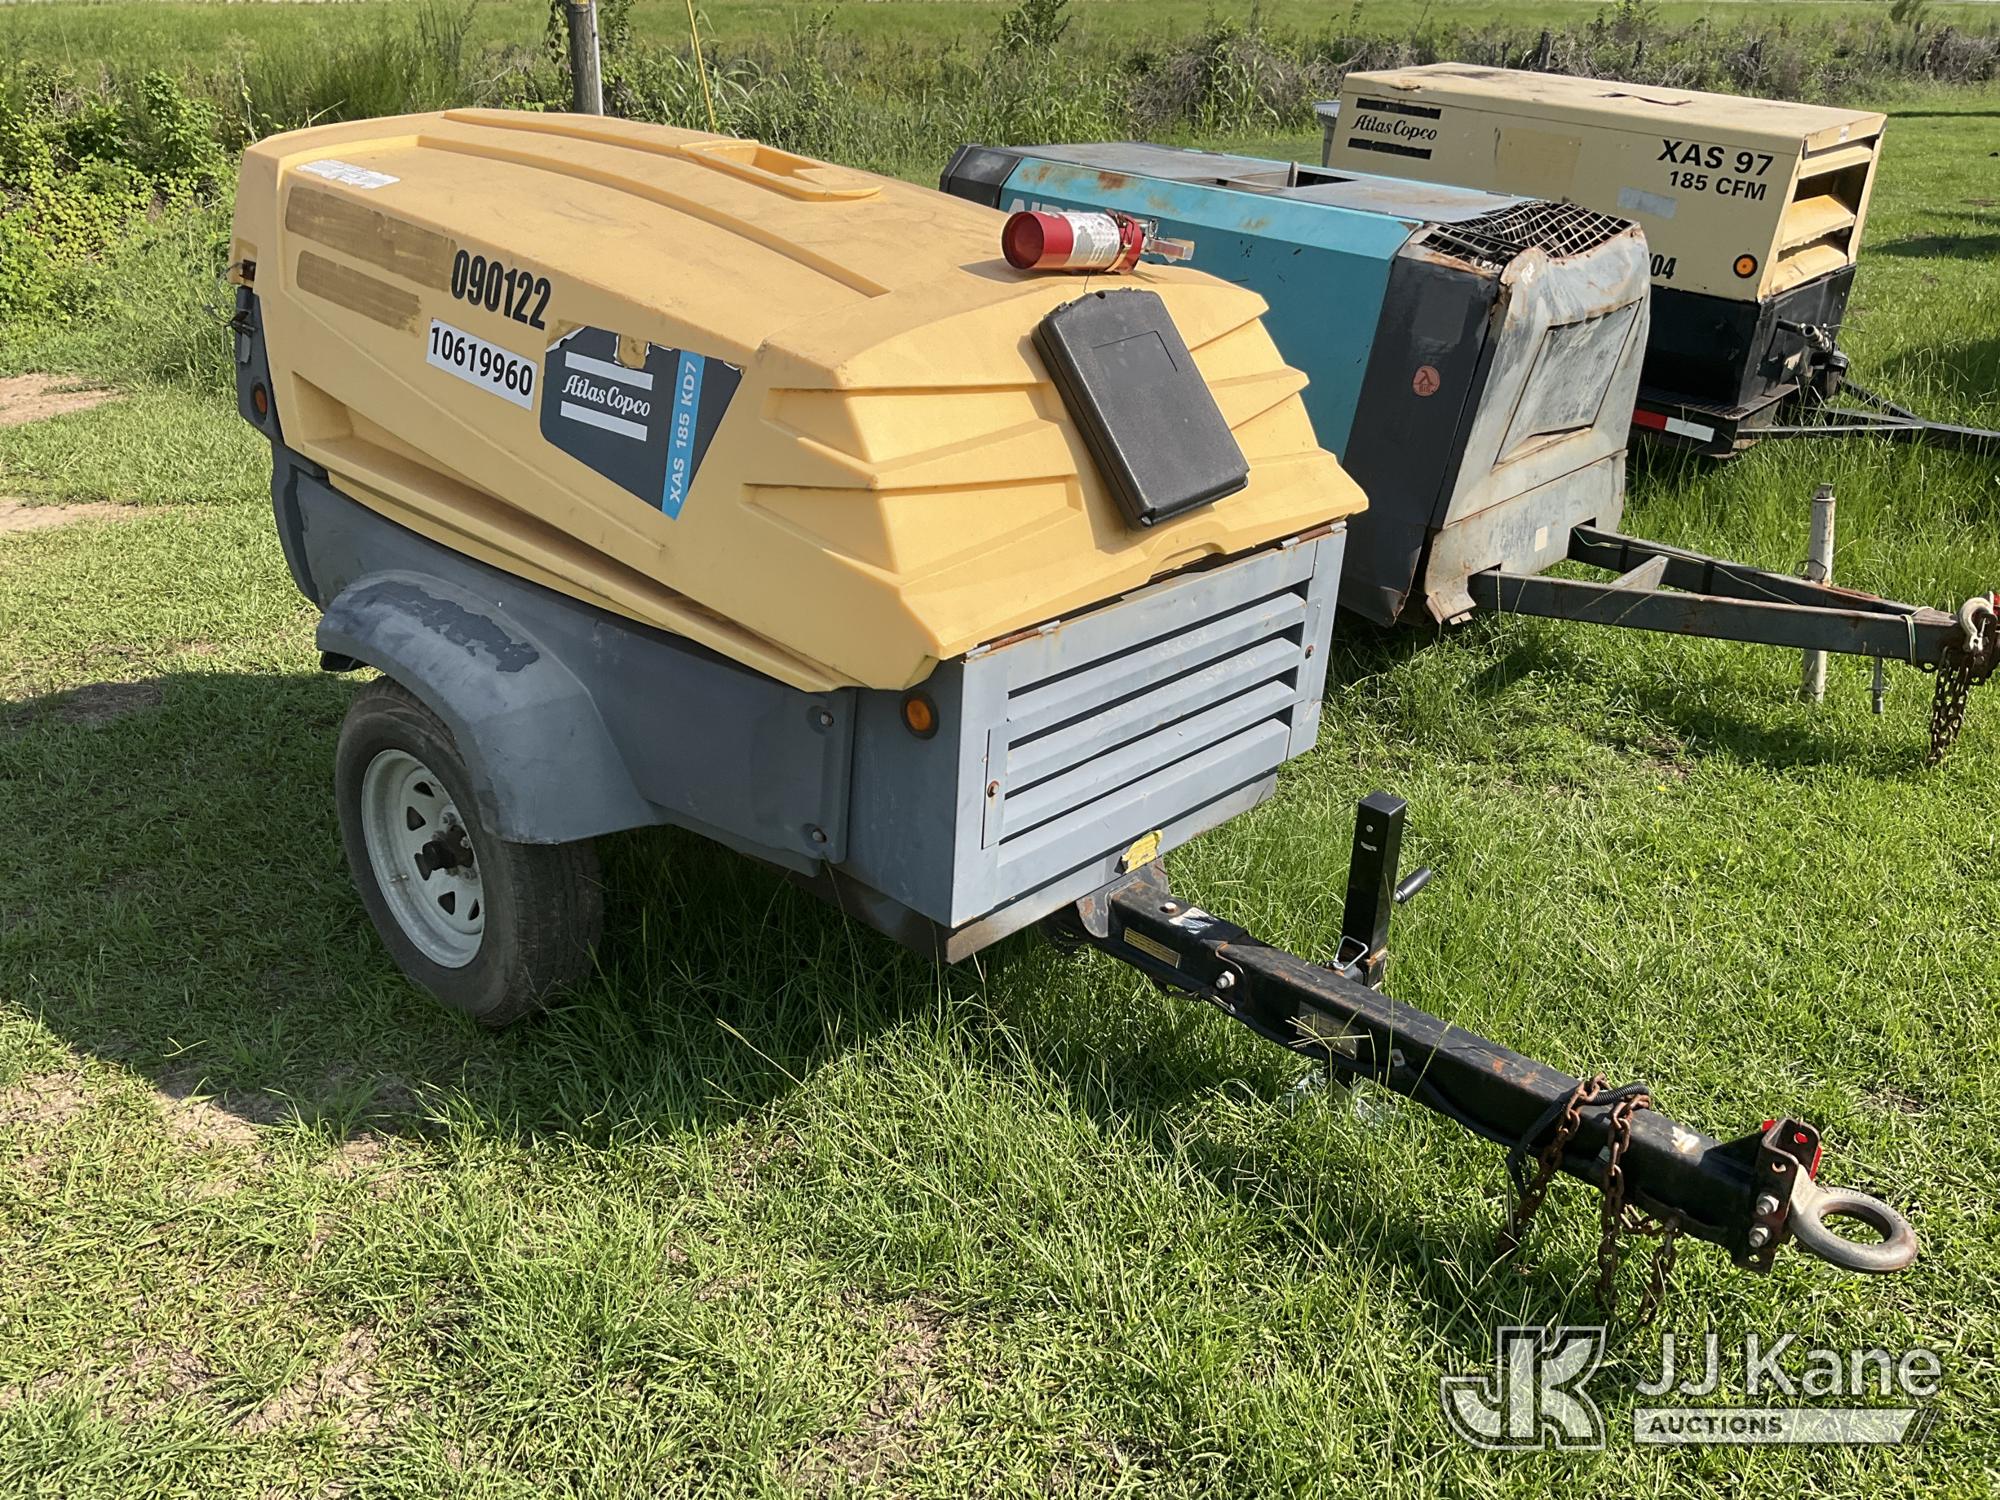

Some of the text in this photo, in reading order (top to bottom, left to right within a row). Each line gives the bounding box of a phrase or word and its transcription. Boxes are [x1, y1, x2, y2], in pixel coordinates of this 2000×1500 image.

[1350, 114, 1438, 140] Atlas Copco
[1656, 138, 1774, 176] XAS 97
[1669, 170, 1768, 201] 185 CFM
[1649, 253, 1677, 279] 04
[451, 249, 551, 331] 090122
[431, 326, 533, 396] 10619960
[562, 374, 651, 417] Atlas Copco
[669, 361, 697, 503] XAS 185 KD7
